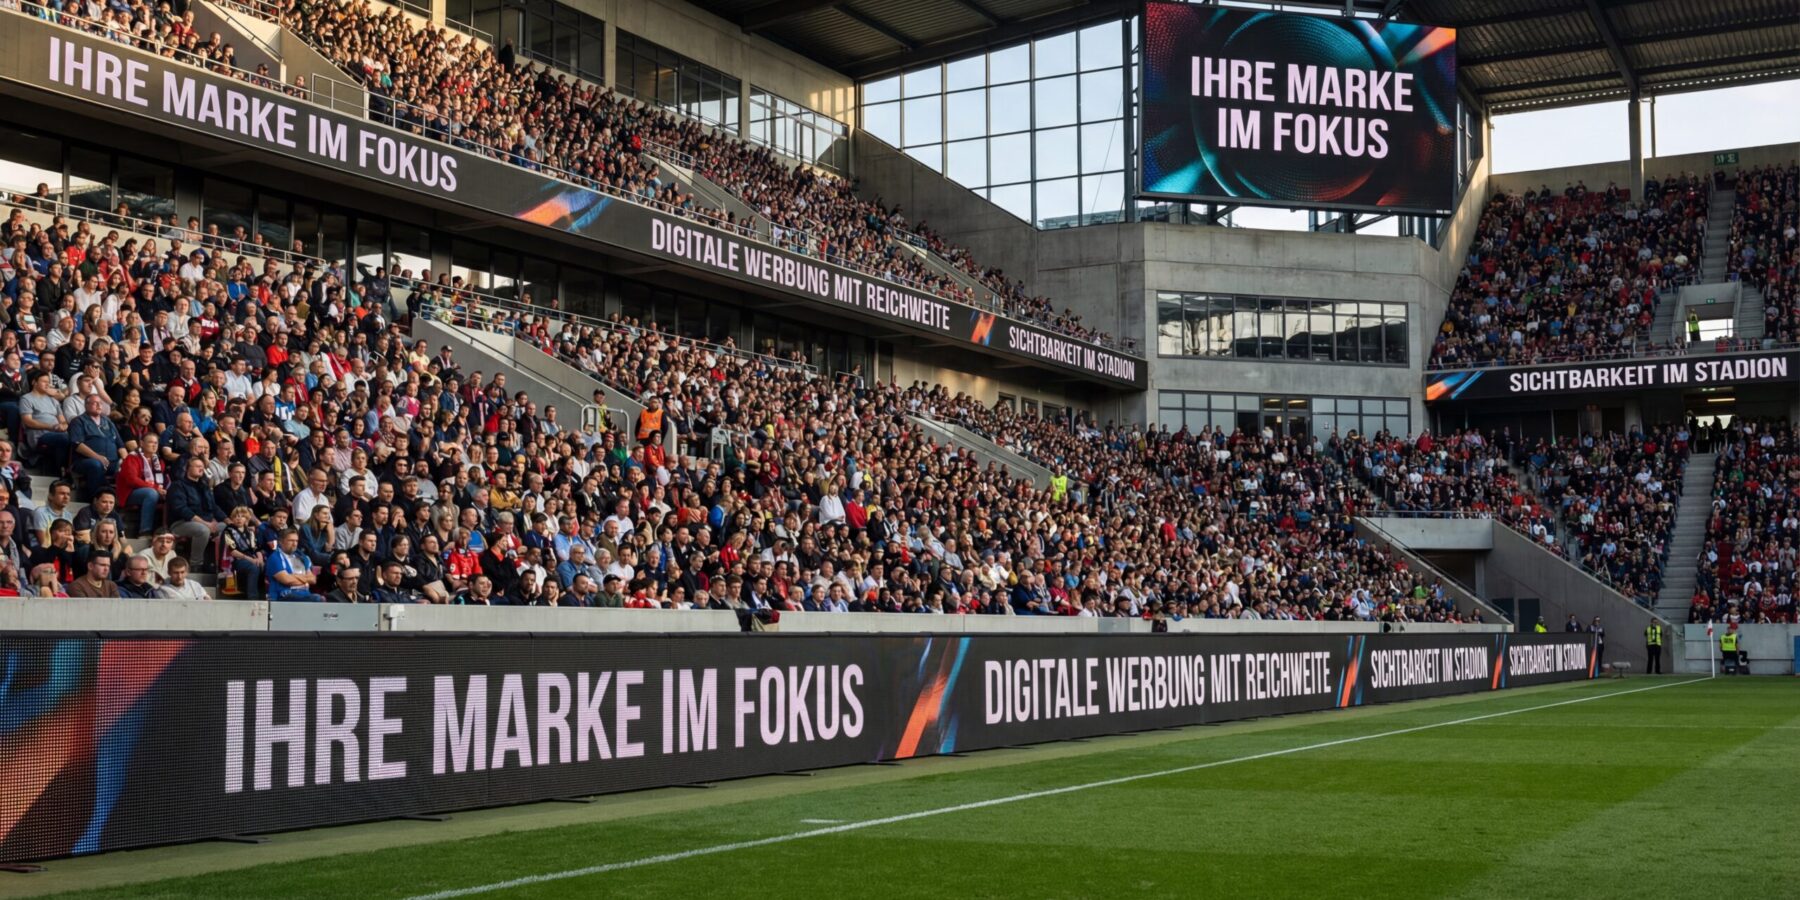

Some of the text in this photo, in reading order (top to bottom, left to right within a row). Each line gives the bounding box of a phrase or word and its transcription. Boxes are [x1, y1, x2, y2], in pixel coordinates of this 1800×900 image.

[1191, 55, 1414, 112] IHRE MARKE
[49, 36, 458, 193] IHRE MARKE IM FOKUS
[1218, 107, 1389, 159] IM FOKUS
[651, 218, 951, 331] DIGITALE WERBUNG MIT REICHWEITE
[1009, 326, 1135, 381] SICHTBARKEIT IM STADION
[1509, 356, 1788, 392] SICHTBARKEIT IM STADION
[984, 651, 1332, 725] DIGITALE WERBUNG MIT REICHWEITE
[1370, 647, 1489, 689] SICHTBARKEIT IM STADION
[1509, 644, 1587, 676] SICHTBARKEIT IM STADION
[225, 663, 864, 793] IHRE MARKE IM FOKUS
